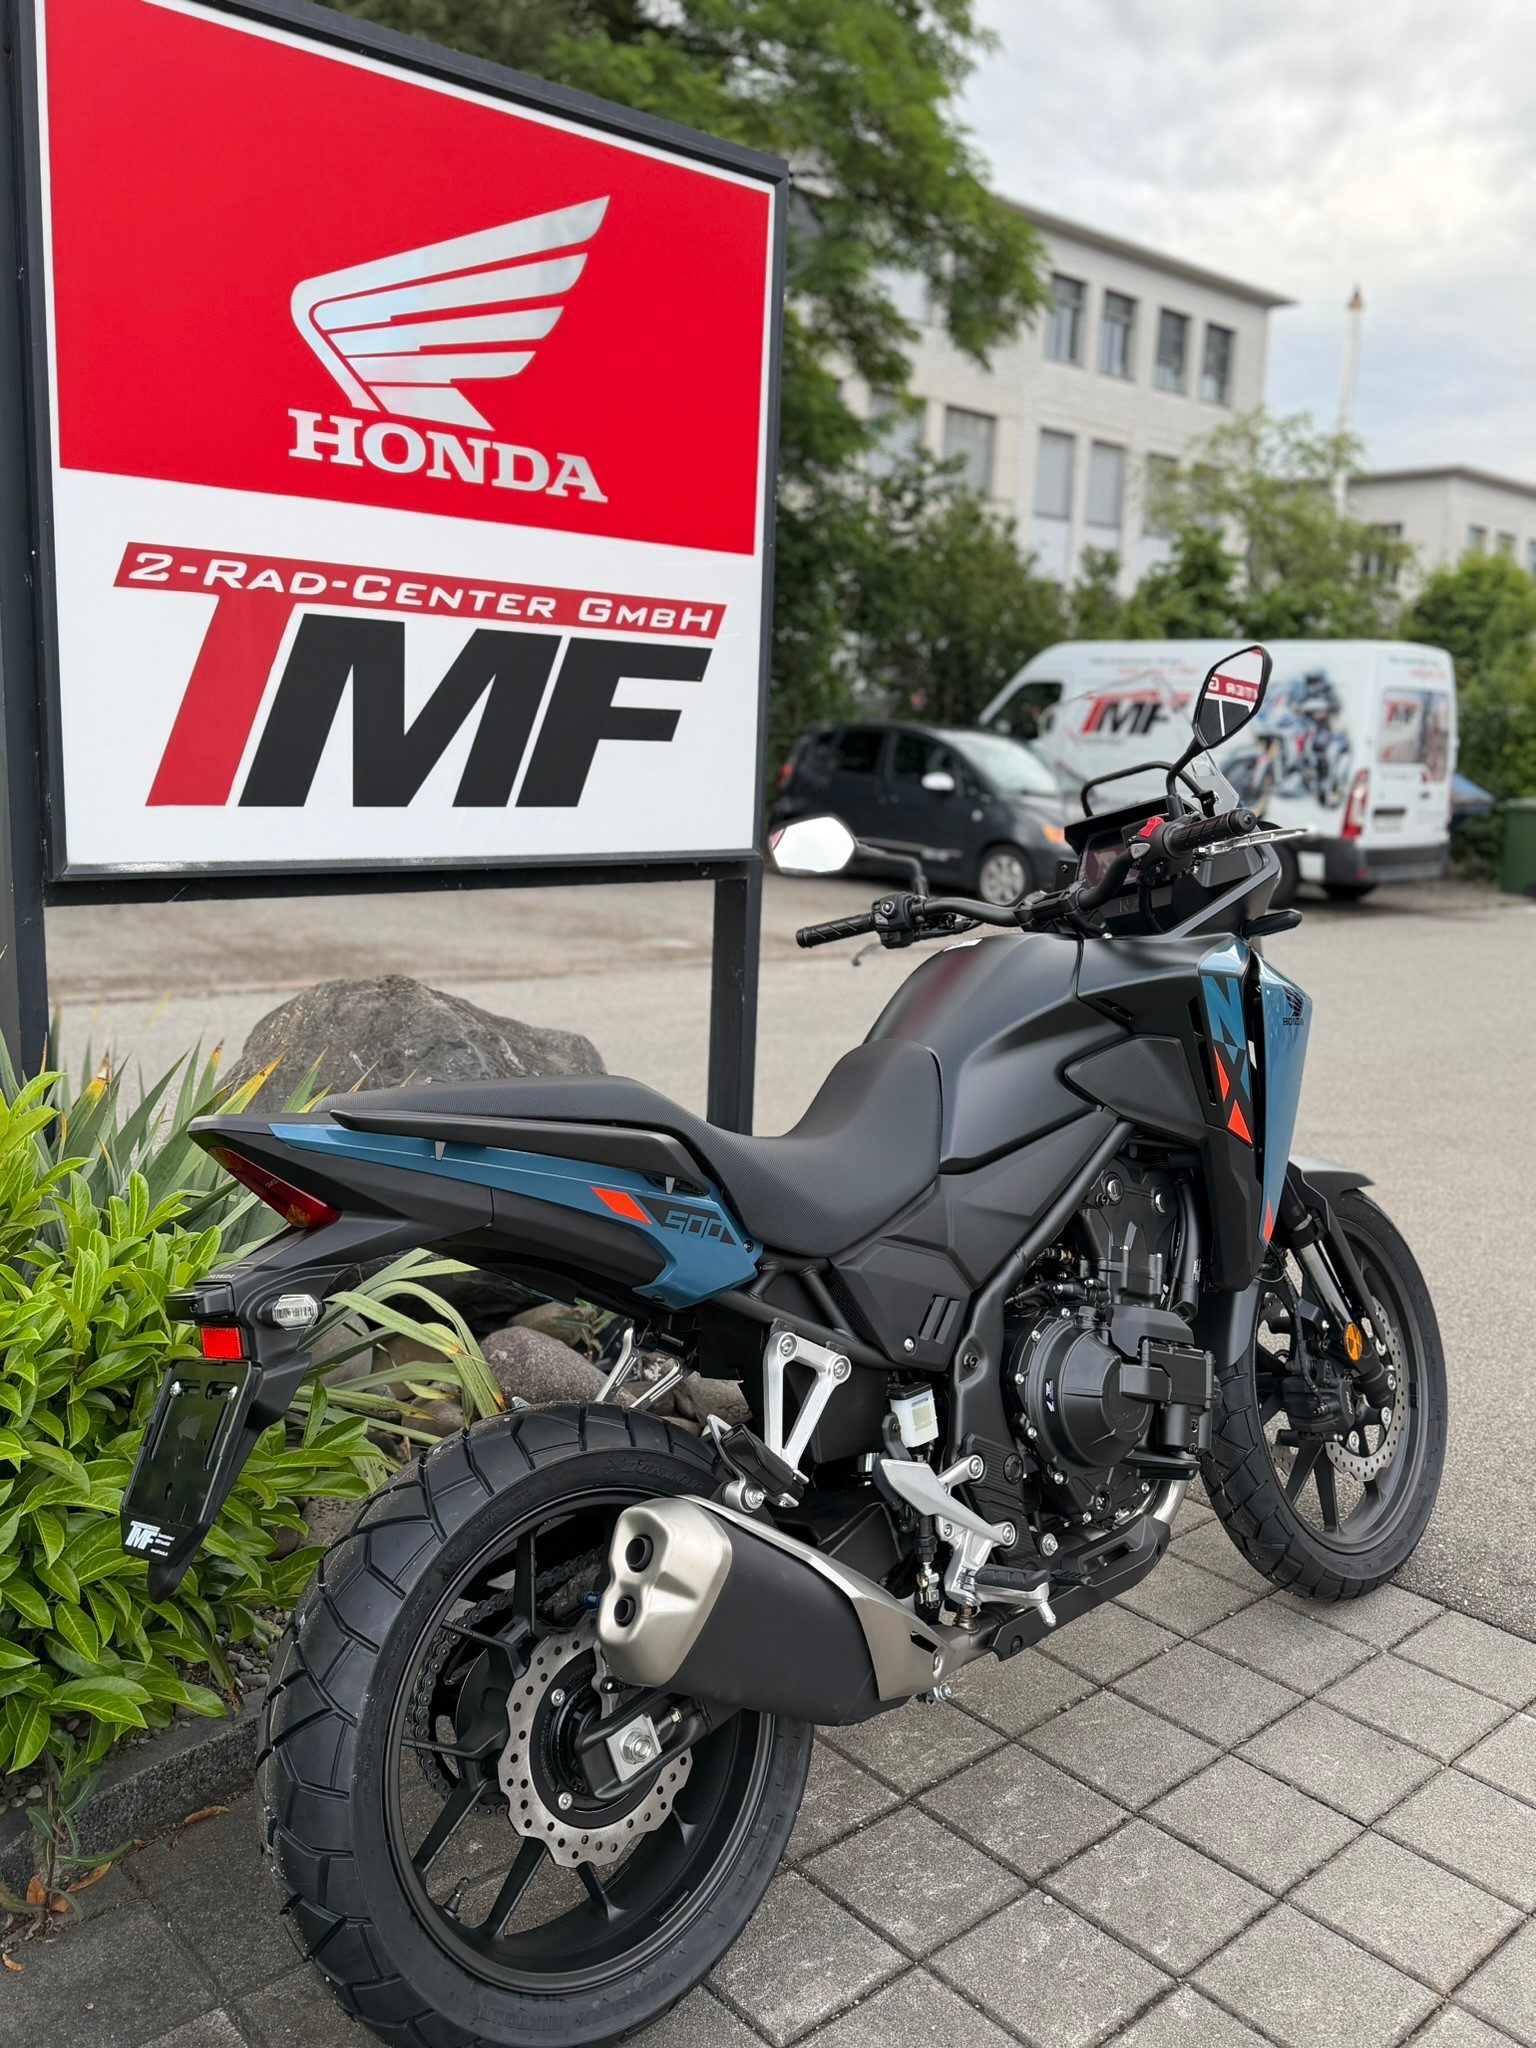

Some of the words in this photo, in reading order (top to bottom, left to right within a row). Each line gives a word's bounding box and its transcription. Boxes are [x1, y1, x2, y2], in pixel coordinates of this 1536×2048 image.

[287, 408, 608, 503] HONDA
[145, 592, 713, 807] TMF
[665, 1210, 725, 1241] 500
[125, 1522, 159, 1550] TMF
